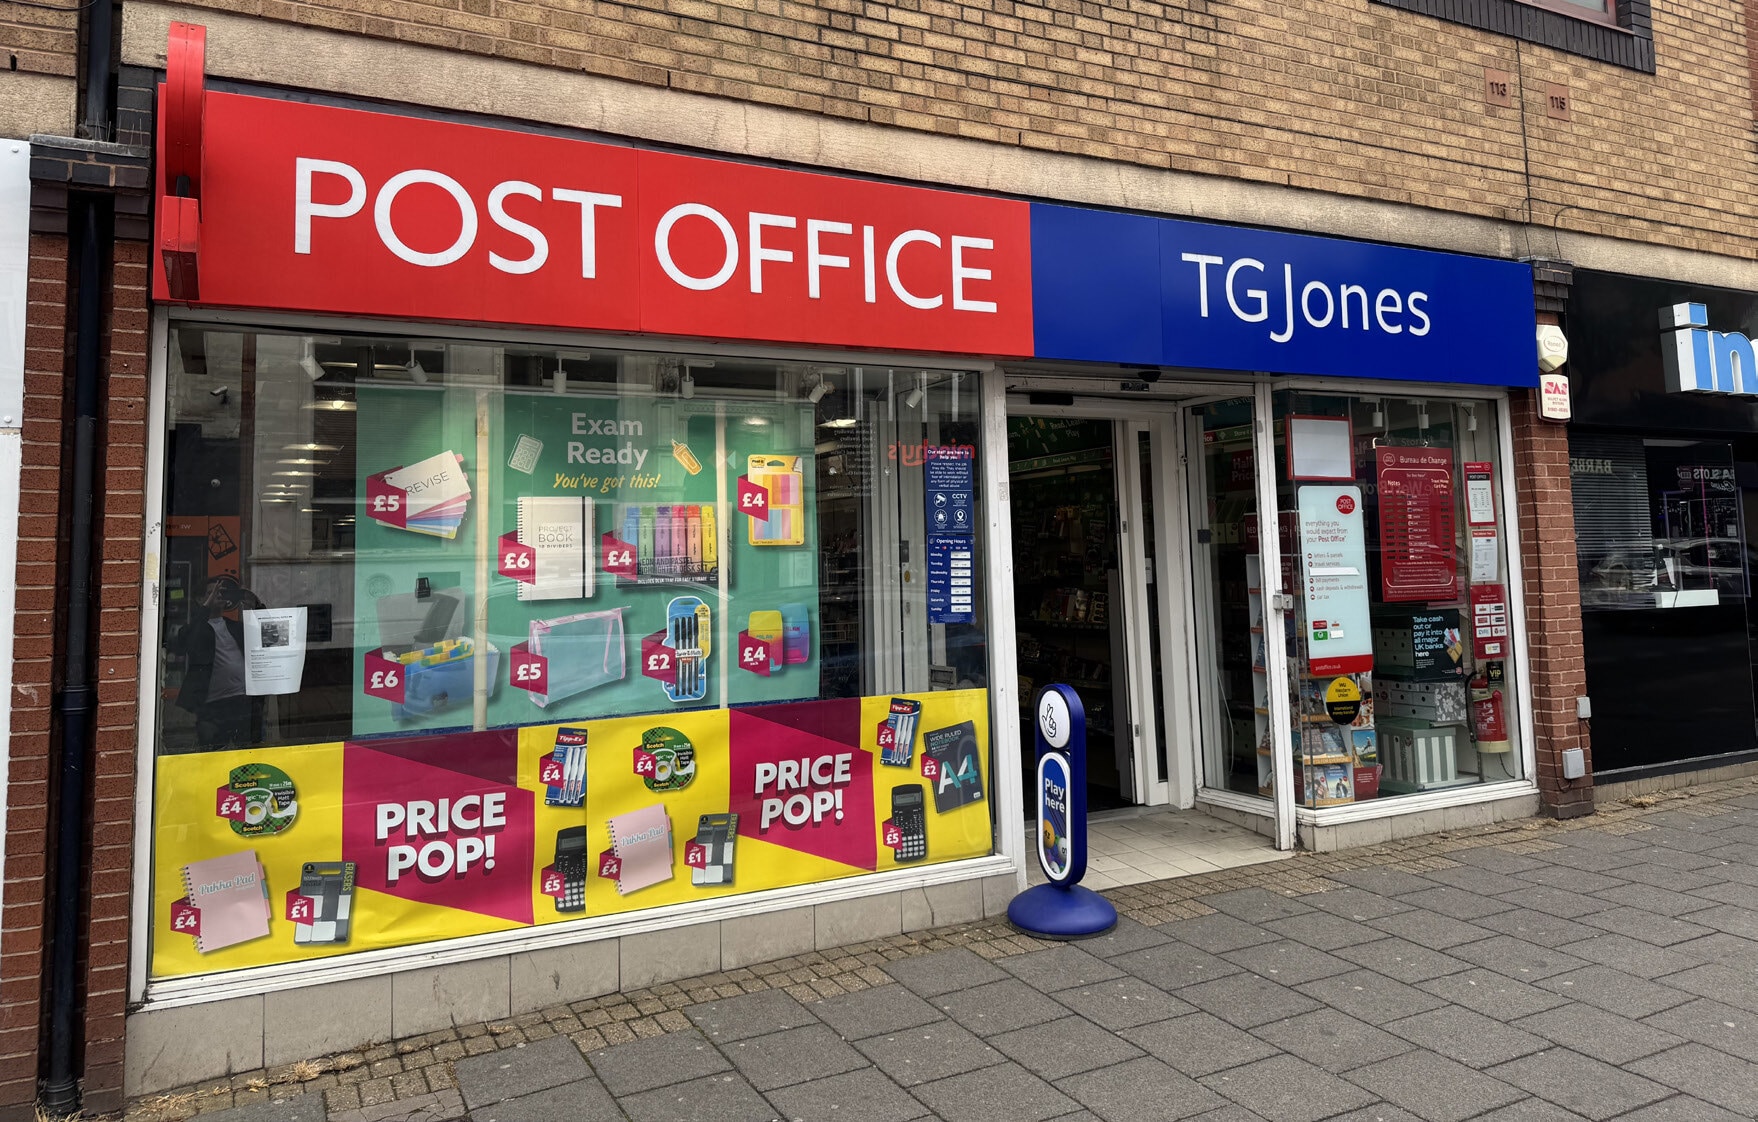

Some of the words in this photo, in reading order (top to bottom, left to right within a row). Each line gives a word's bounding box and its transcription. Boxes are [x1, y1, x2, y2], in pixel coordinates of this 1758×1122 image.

[1489, 81, 1507, 96] 113
[1549, 95, 1566, 110] 115
[294, 157, 622, 279] POST
[653, 203, 998, 314] OFFICE
[571, 412, 643, 436] Exam
[567, 441, 649, 471] Ready
[1400, 456, 1419, 464] Bureau
[1428, 456, 1447, 465] Change
[404, 471, 450, 496] REVISE
[552, 472, 598, 489] You've
[600, 474, 625, 494] got
[629, 473, 661, 489] this!
[373, 495, 400, 512] £5
[742, 492, 764, 507] £4
[538, 533, 573, 543] BOOK
[504, 552, 530, 569] £6
[607, 550, 632, 567] £4
[1421, 636, 1439, 644] major
[743, 646, 766, 662] £4
[647, 654, 670, 671] £2
[370, 670, 399, 689] £6
[517, 663, 542, 681] £5
[1489, 669, 1501, 677] VIP
[879, 734, 893, 745] £4
[929, 734, 944, 743] WIDE
[944, 729, 962, 739] RULED
[930, 735, 960, 747] NOTEBOOK
[636, 761, 653, 773] £4
[755, 752, 852, 794] PRICE
[923, 765, 937, 776] £2
[938, 754, 978, 795] A4
[542, 769, 561, 782] £4
[1045, 777, 1065, 800] Play
[221, 801, 242, 815] £4
[760, 788, 844, 829] POP!
[1045, 792, 1065, 813] here
[377, 792, 506, 839] PRICE
[620, 832, 647, 847] Pukka
[648, 824, 665, 839] Pad
[886, 833, 899, 844] £5
[388, 834, 496, 880] POP!
[688, 852, 702, 863] £1
[343, 862, 355, 892] ERASERS
[601, 863, 618, 876] £4
[198, 878, 233, 896] Pukka
[234, 873, 256, 886] Pad
[544, 880, 561, 893] £5
[291, 906, 308, 918] £1
[175, 916, 197, 929] £4
